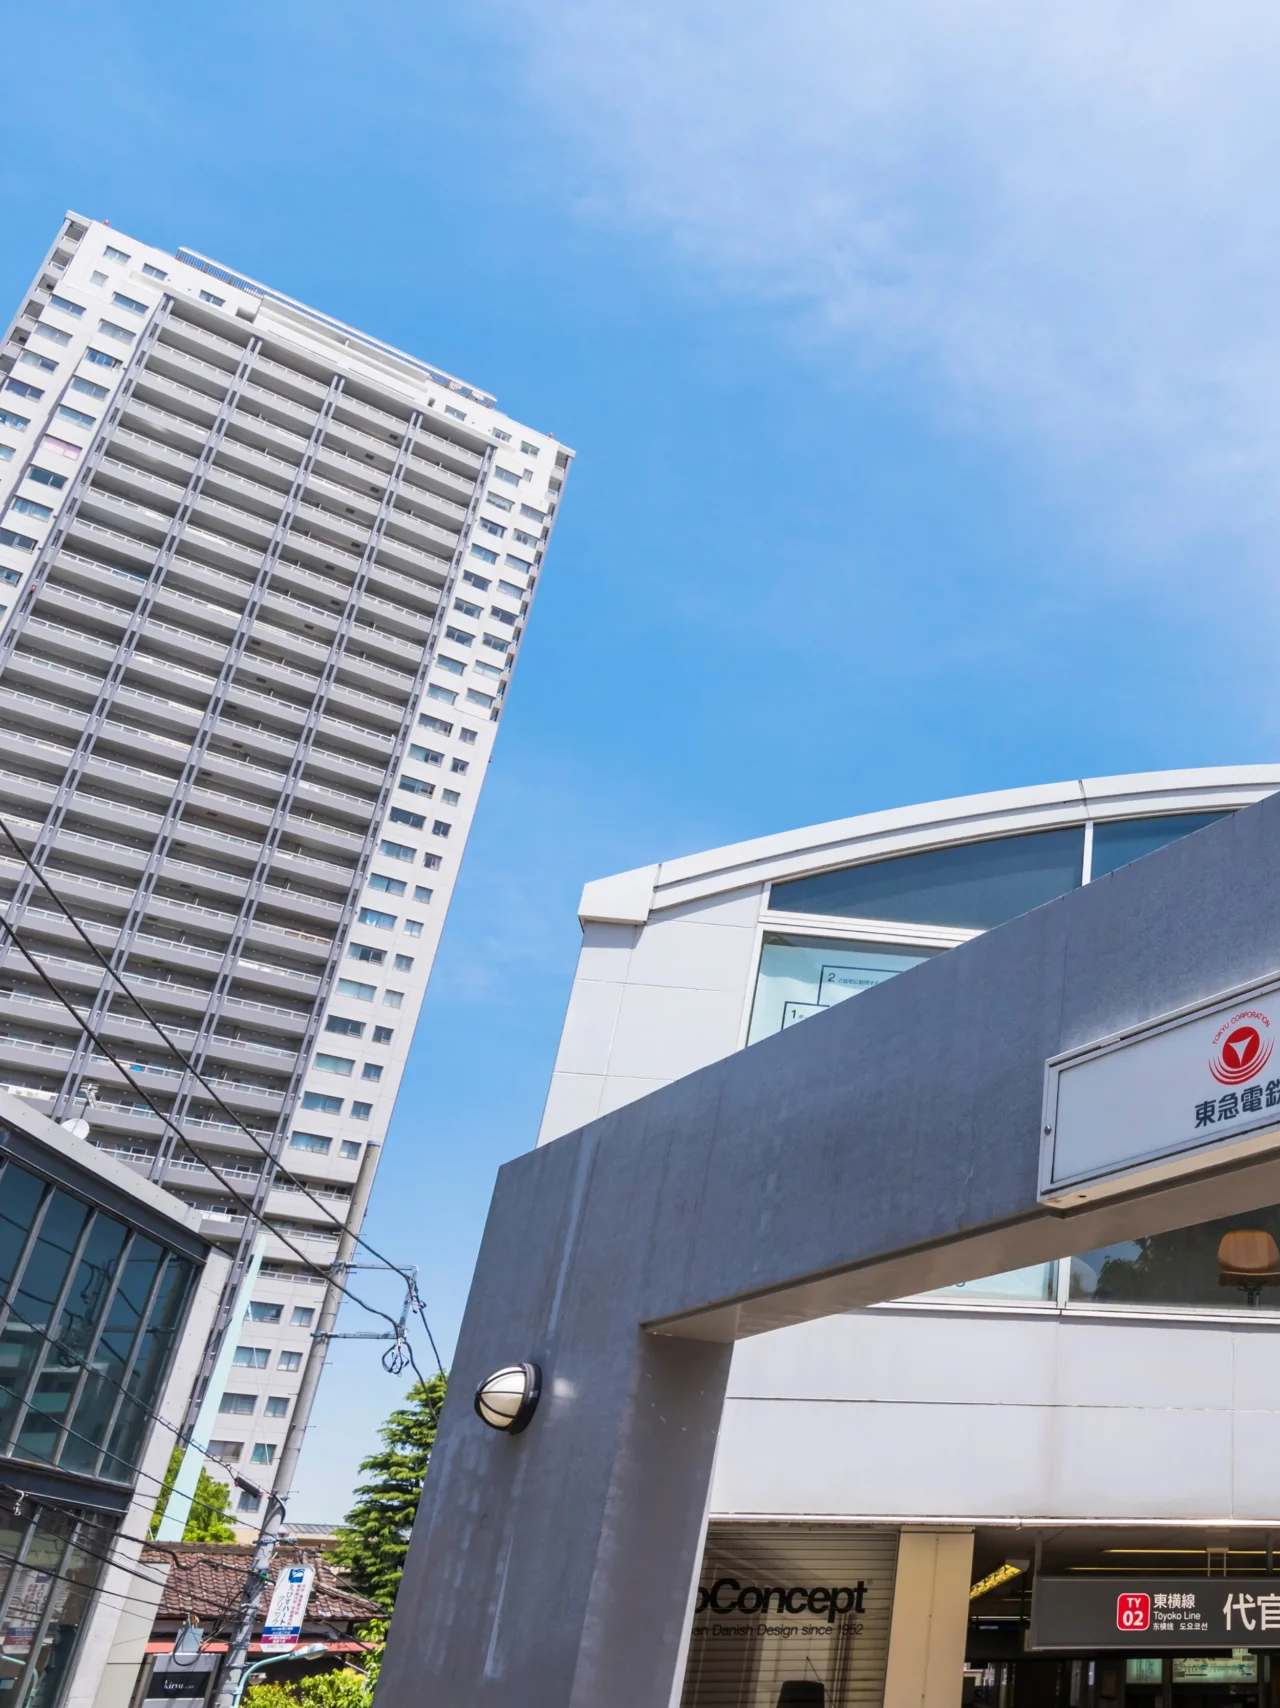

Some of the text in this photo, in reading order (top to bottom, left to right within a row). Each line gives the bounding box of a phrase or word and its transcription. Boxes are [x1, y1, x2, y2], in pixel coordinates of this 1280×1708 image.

[828, 972, 836, 983] 2
[1212, 1011, 1271, 1045] TOKYU CORPORATION
[1127, 1598, 1141, 1608] TY
[1153, 1593, 1196, 1609] 東横線
[1123, 1610, 1144, 1626] 02
[1184, 1611, 1201, 1620] Line
[712, 1624, 753, 1636] Danish
[757, 1624, 798, 1638] Design
[801, 1624, 833, 1636] since
[837, 1624, 864, 1635] 1952
[1179, 1622, 1208, 1631] 도요코선
